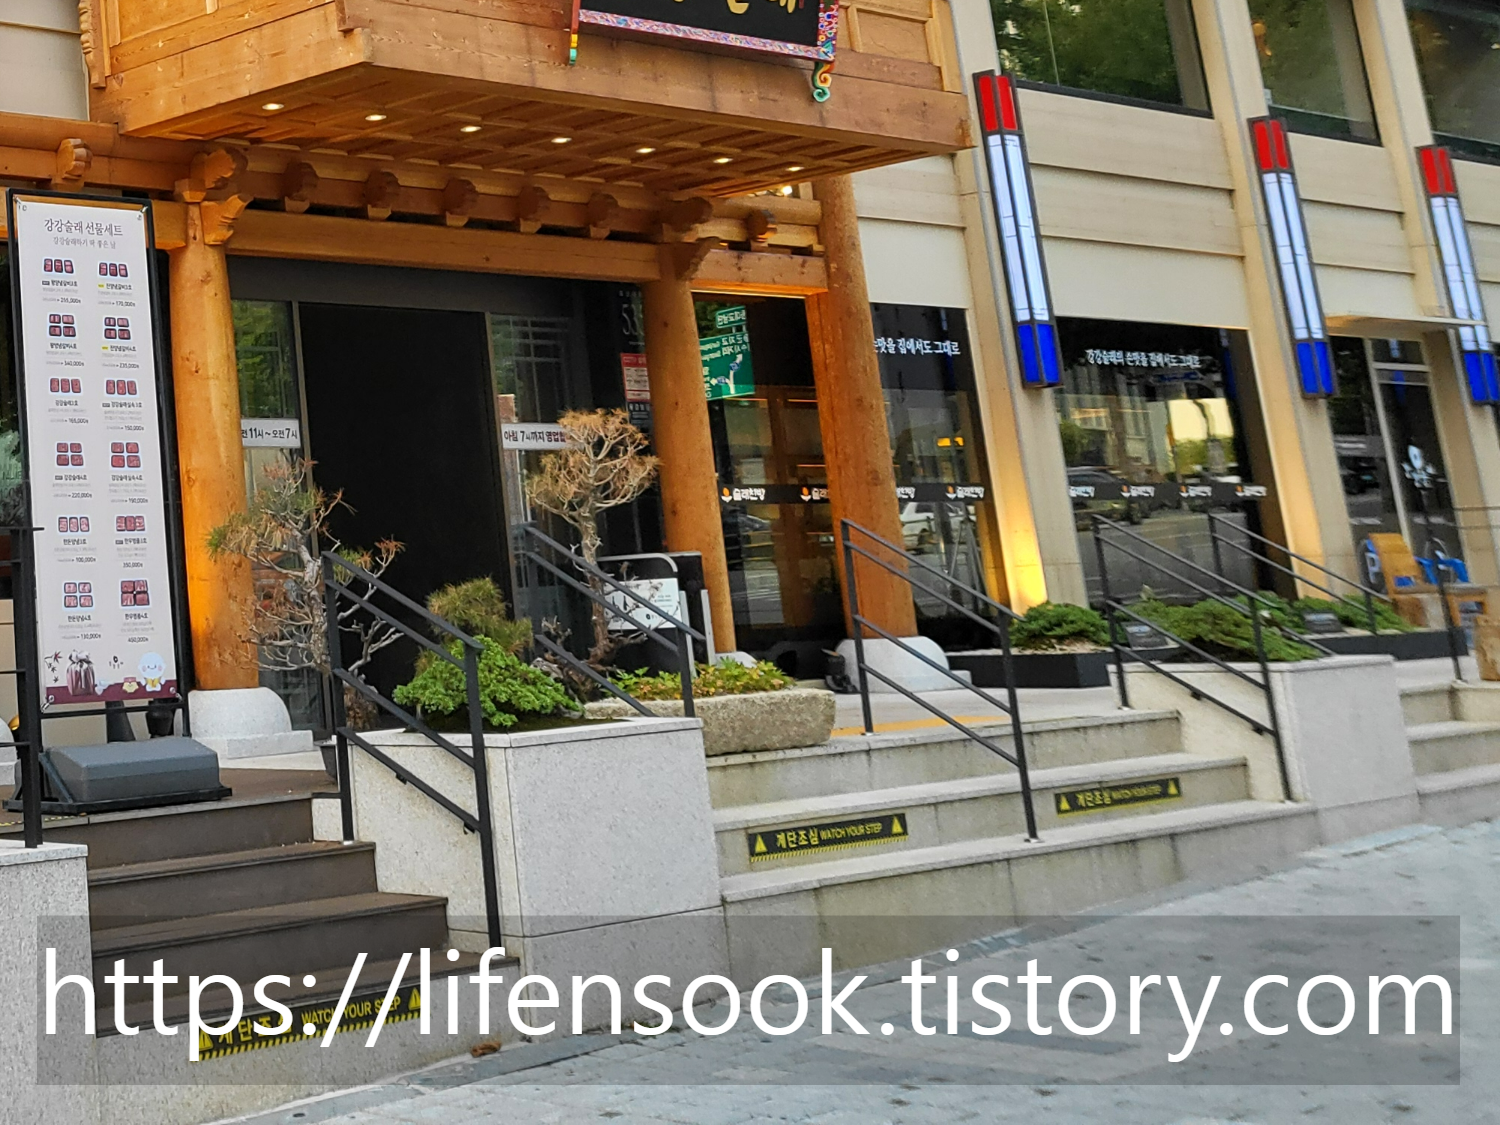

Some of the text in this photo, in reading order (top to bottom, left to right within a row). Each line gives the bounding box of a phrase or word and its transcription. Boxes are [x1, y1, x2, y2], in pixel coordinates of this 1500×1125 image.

[44, 218, 123, 236] 강강술래 선물세트
[504, 430, 518, 442] 아침
[776, 822, 882, 849] 계단조심 WATCH YOUR STEP
[374, 995, 401, 1013] SEP
